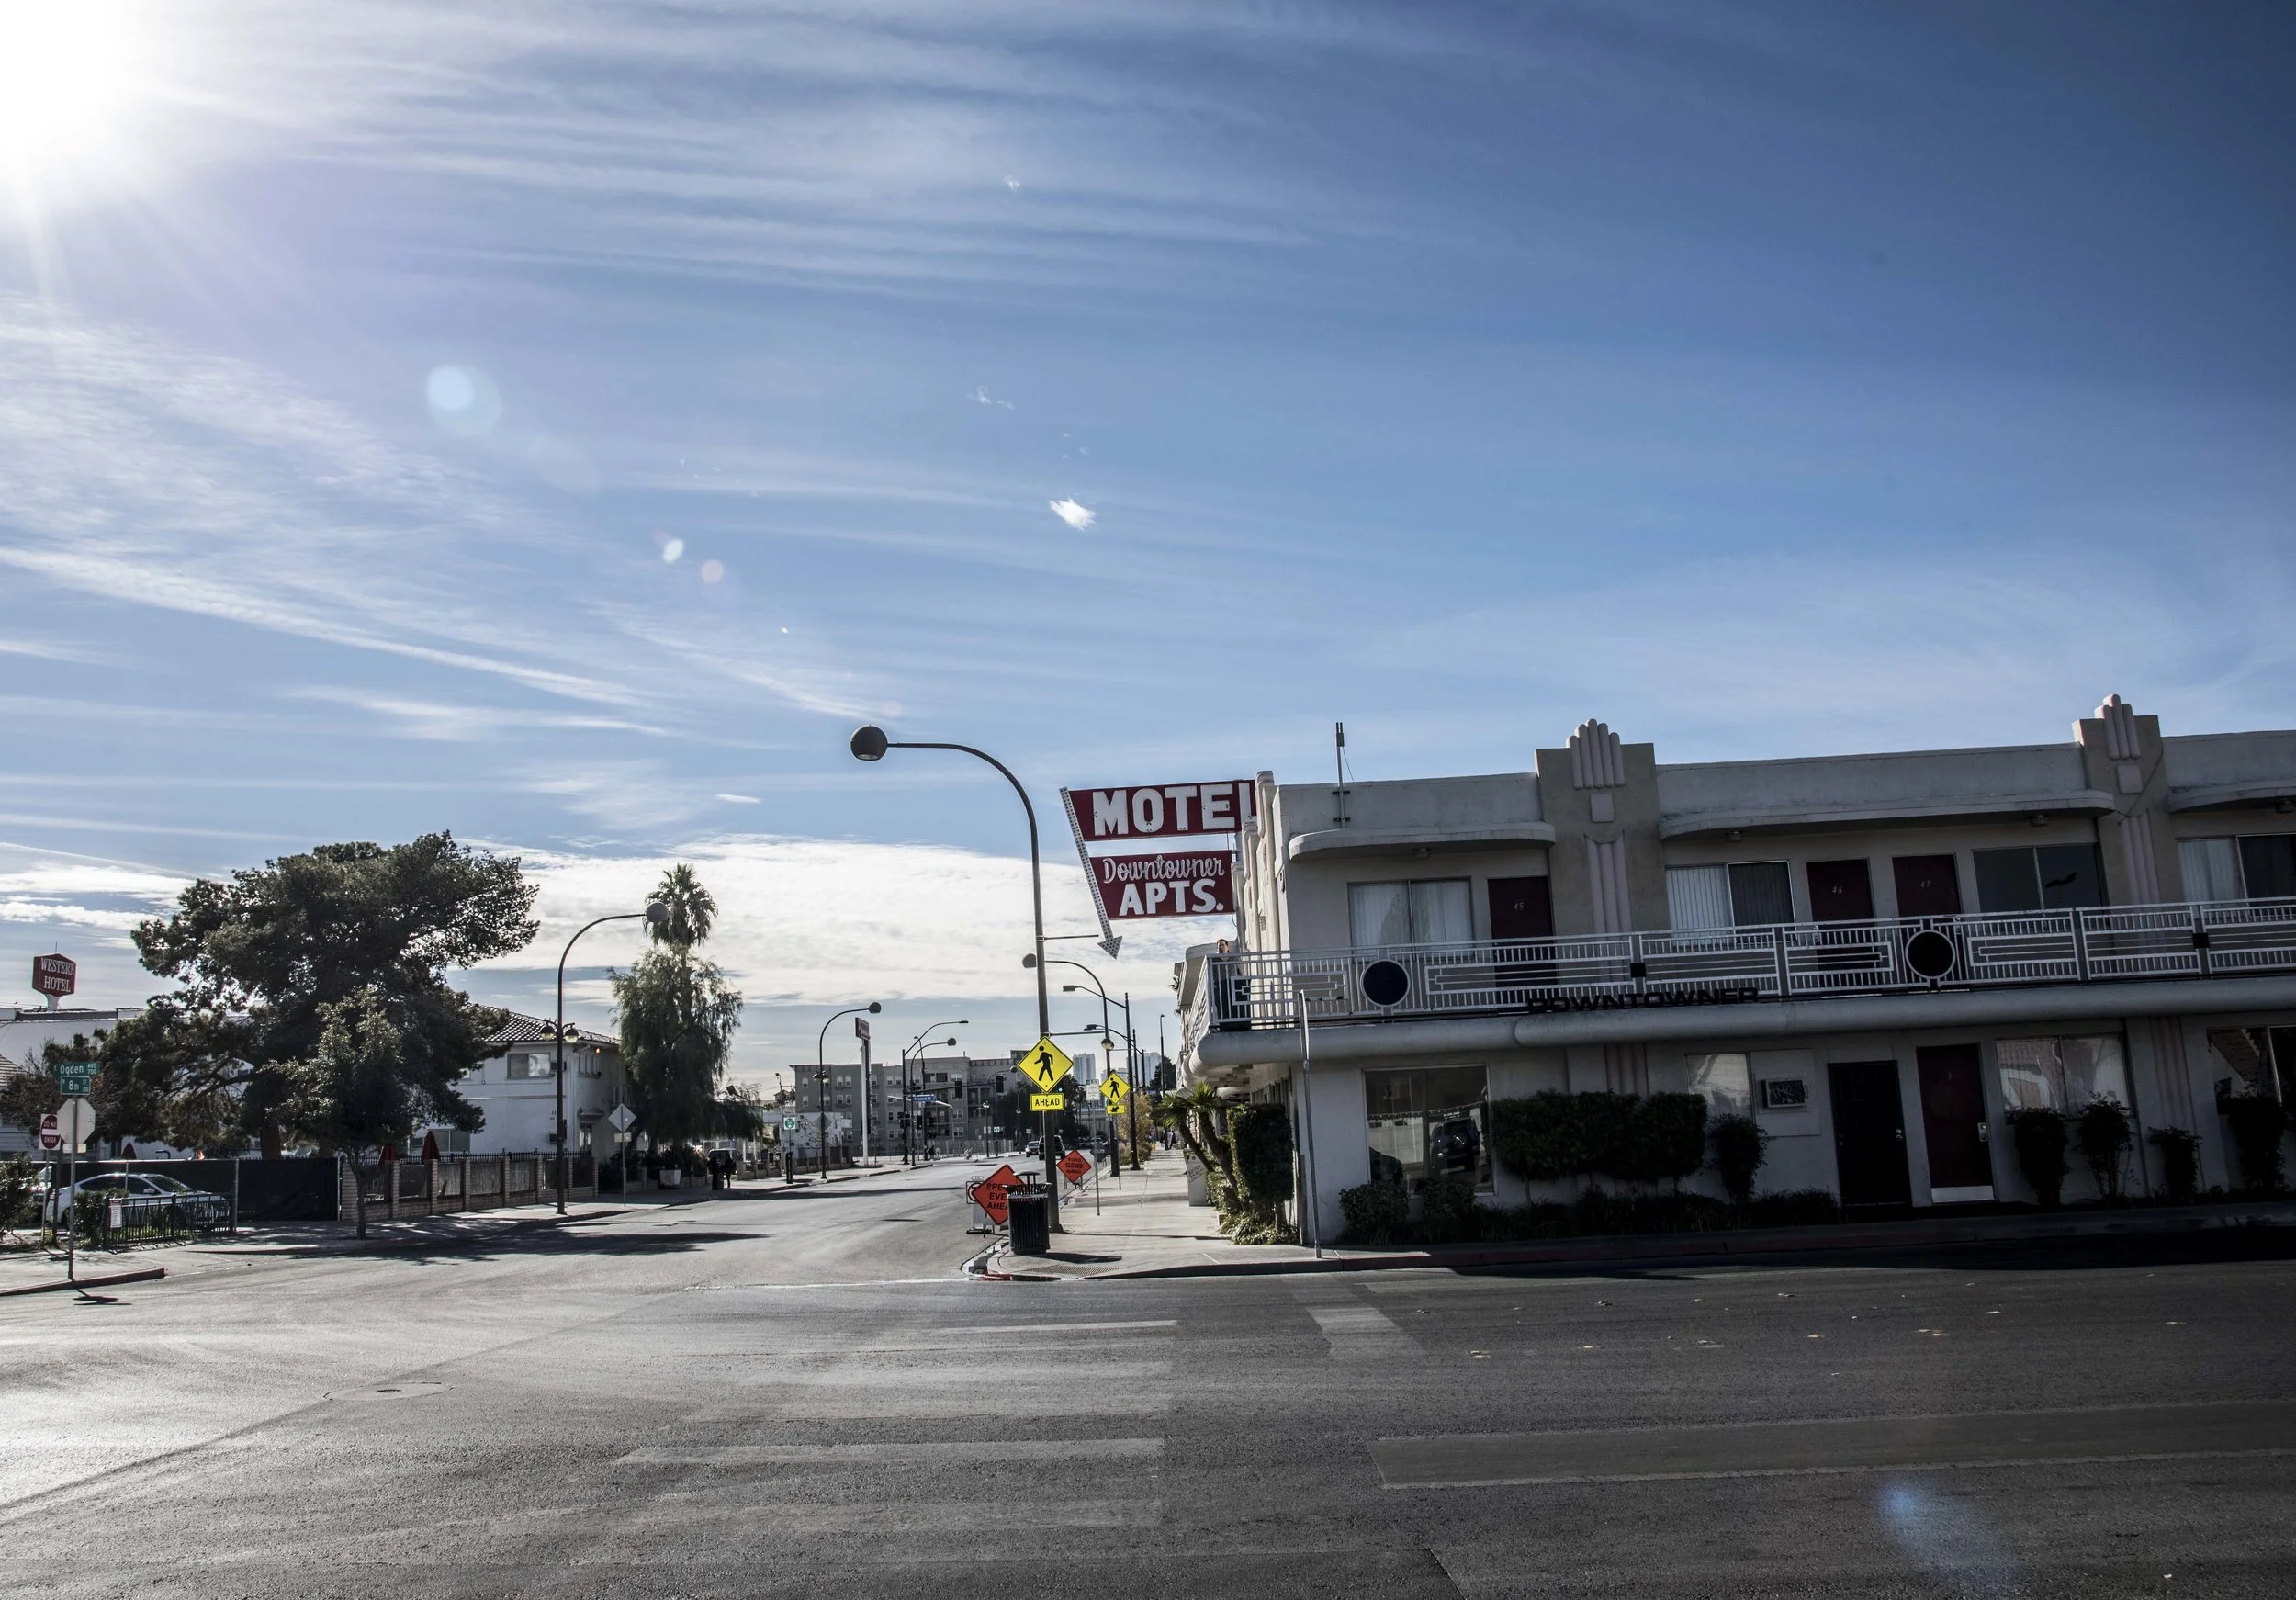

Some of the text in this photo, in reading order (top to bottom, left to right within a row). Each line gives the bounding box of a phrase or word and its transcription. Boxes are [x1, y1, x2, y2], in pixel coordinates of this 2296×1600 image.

[1093, 783, 1257, 837] MOTEL
[1103, 855, 1225, 884] Downtowner
[1120, 879, 1224, 917] APTS.
[1832, 885, 1843, 895] 46
[40, 957, 75, 975] WESTERN
[43, 975, 72, 992] HOTEL
[1528, 987, 1758, 1014] DOWNTOWNER
[60, 1065, 84, 1077] Ogden
[1034, 1098, 1060, 1108] AHEAD
[989, 1192, 1007, 1200] EVE
[986, 1201, 1008, 1211] AHE
